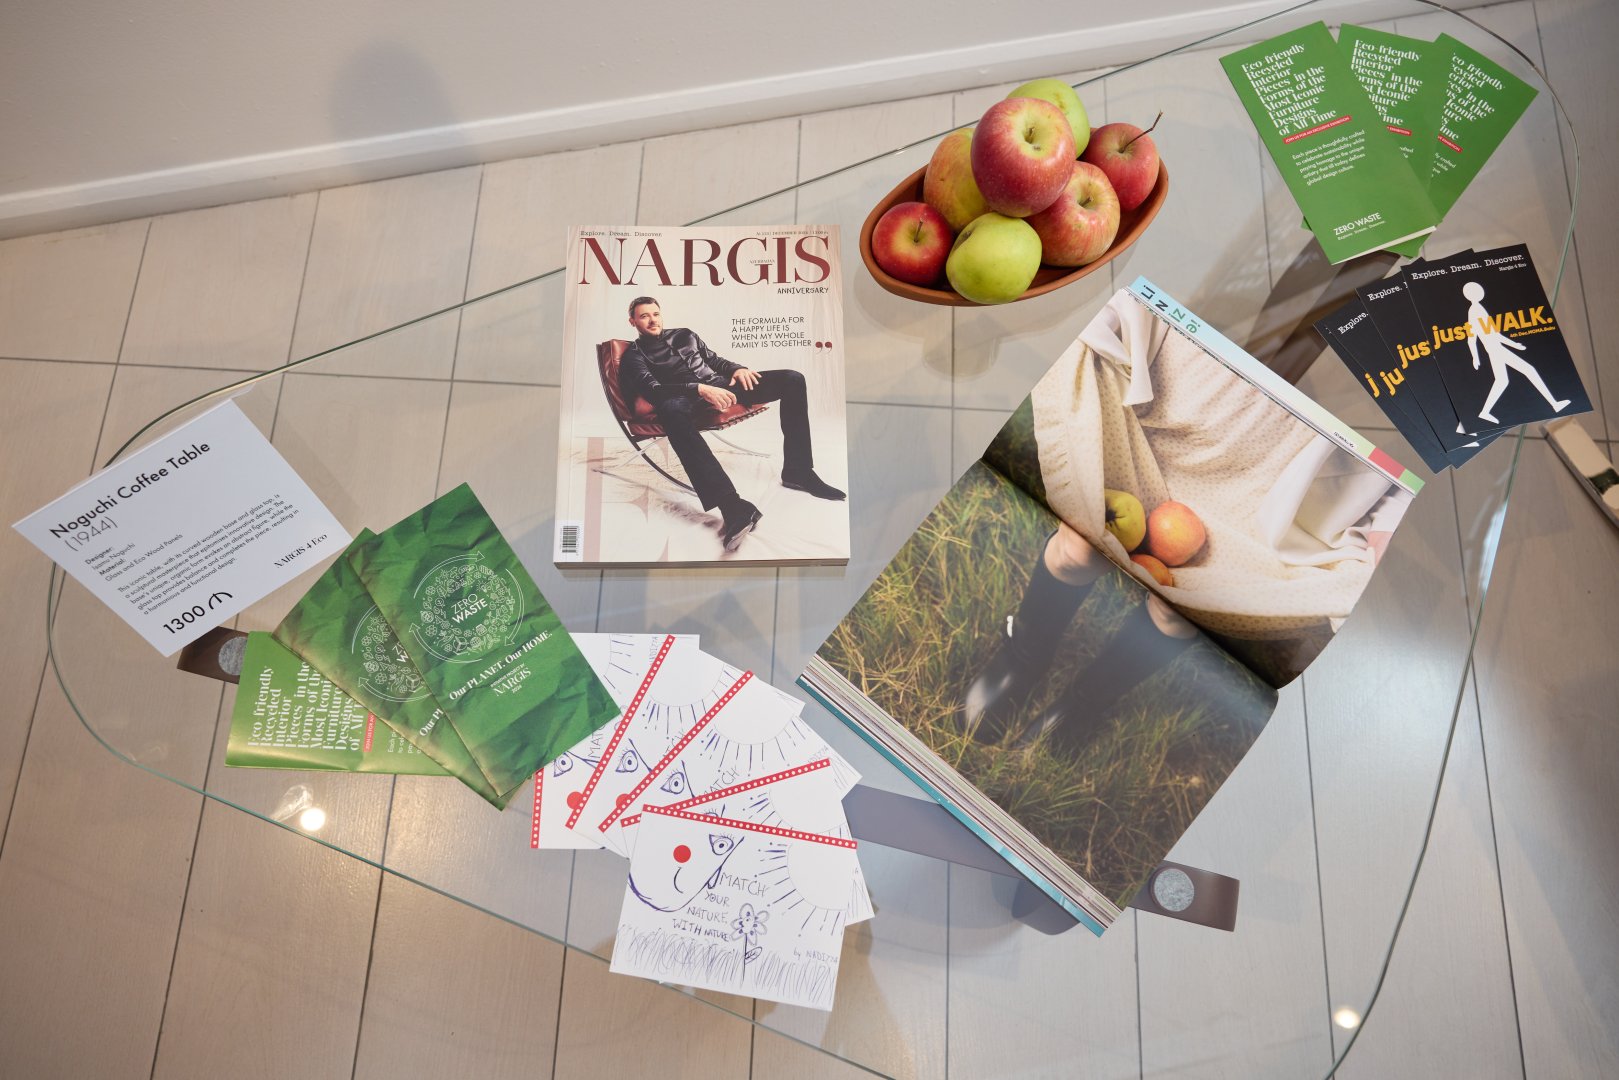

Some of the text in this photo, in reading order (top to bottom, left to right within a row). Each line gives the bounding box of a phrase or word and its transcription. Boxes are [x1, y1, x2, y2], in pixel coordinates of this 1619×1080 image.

[1246, 57, 1293, 80] Recycled
[1352, 56, 1393, 71] Interior
[1353, 48, 1401, 65] Recycled
[1251, 68, 1290, 88] Interior
[1255, 66, 1324, 96] Pieces in the
[1259, 75, 1325, 104] Forms of the
[1385, 82, 1418, 94] of the
[1391, 73, 1401, 82] in
[1404, 76, 1422, 86] the
[1264, 85, 1324, 111] Most Iconic
[1377, 86, 1410, 101] Iconic
[1269, 97, 1319, 120] Furniture
[1273, 109, 1316, 128] Designs
[1279, 110, 1336, 136] of All Time
[1334, 222, 1355, 235] ZERO
[1354, 212, 1381, 226] WASTE
[578, 236, 831, 287] NARGIS
[1411, 255, 1524, 280] Explore. Dream. Discover.
[777, 287, 829, 295] ANNIVERSARY
[1367, 285, 1402, 301] Explore.
[739, 325, 765, 333] HAPPY
[748, 317, 787, 325] FORMULA
[1337, 312, 1369, 335] Explore.
[1432, 322, 1474, 350] just
[1477, 305, 1553, 335] WALK.
[731, 333, 758, 341] WHEN
[731, 341, 759, 349] FAMILY
[770, 339, 812, 348] TOGETHER
[1396, 341, 1432, 369] jus
[50, 444, 210, 538] Noguchi Coffee Table
[65, 516, 118, 551] (1944)
[91, 544, 135, 570] Isamu Noguchi
[105, 534, 183, 582] Glass and Eco Wood Panels
[274, 548, 306, 567] NARGIS
[311, 534, 327, 546] Eco
[451, 593, 478, 614] ZERO
[452, 598, 488, 623] WASTE
[163, 605, 205, 633] 1300
[449, 686, 466, 700] Our
[467, 661, 505, 688] PLANET.
[505, 650, 522, 664] Our
[522, 631, 552, 652] HOME.
[494, 668, 531, 696] NARGIS
[285, 662, 310, 748] Pieces in the
[310, 680, 331, 749] Most Iconi
[260, 689, 281, 747] Recycled
[272, 697, 291, 747] Interior
[298, 689, 318, 748] Forms of
[335, 697, 353, 750] Designs
[419, 719, 435, 736] Our
[349, 714, 364, 751] of All
[720, 871, 767, 897] MATCH
[704, 891, 730, 907] YOUR
[687, 906, 728, 924] NATURE
[672, 918, 730, 942] WITH NATURE
